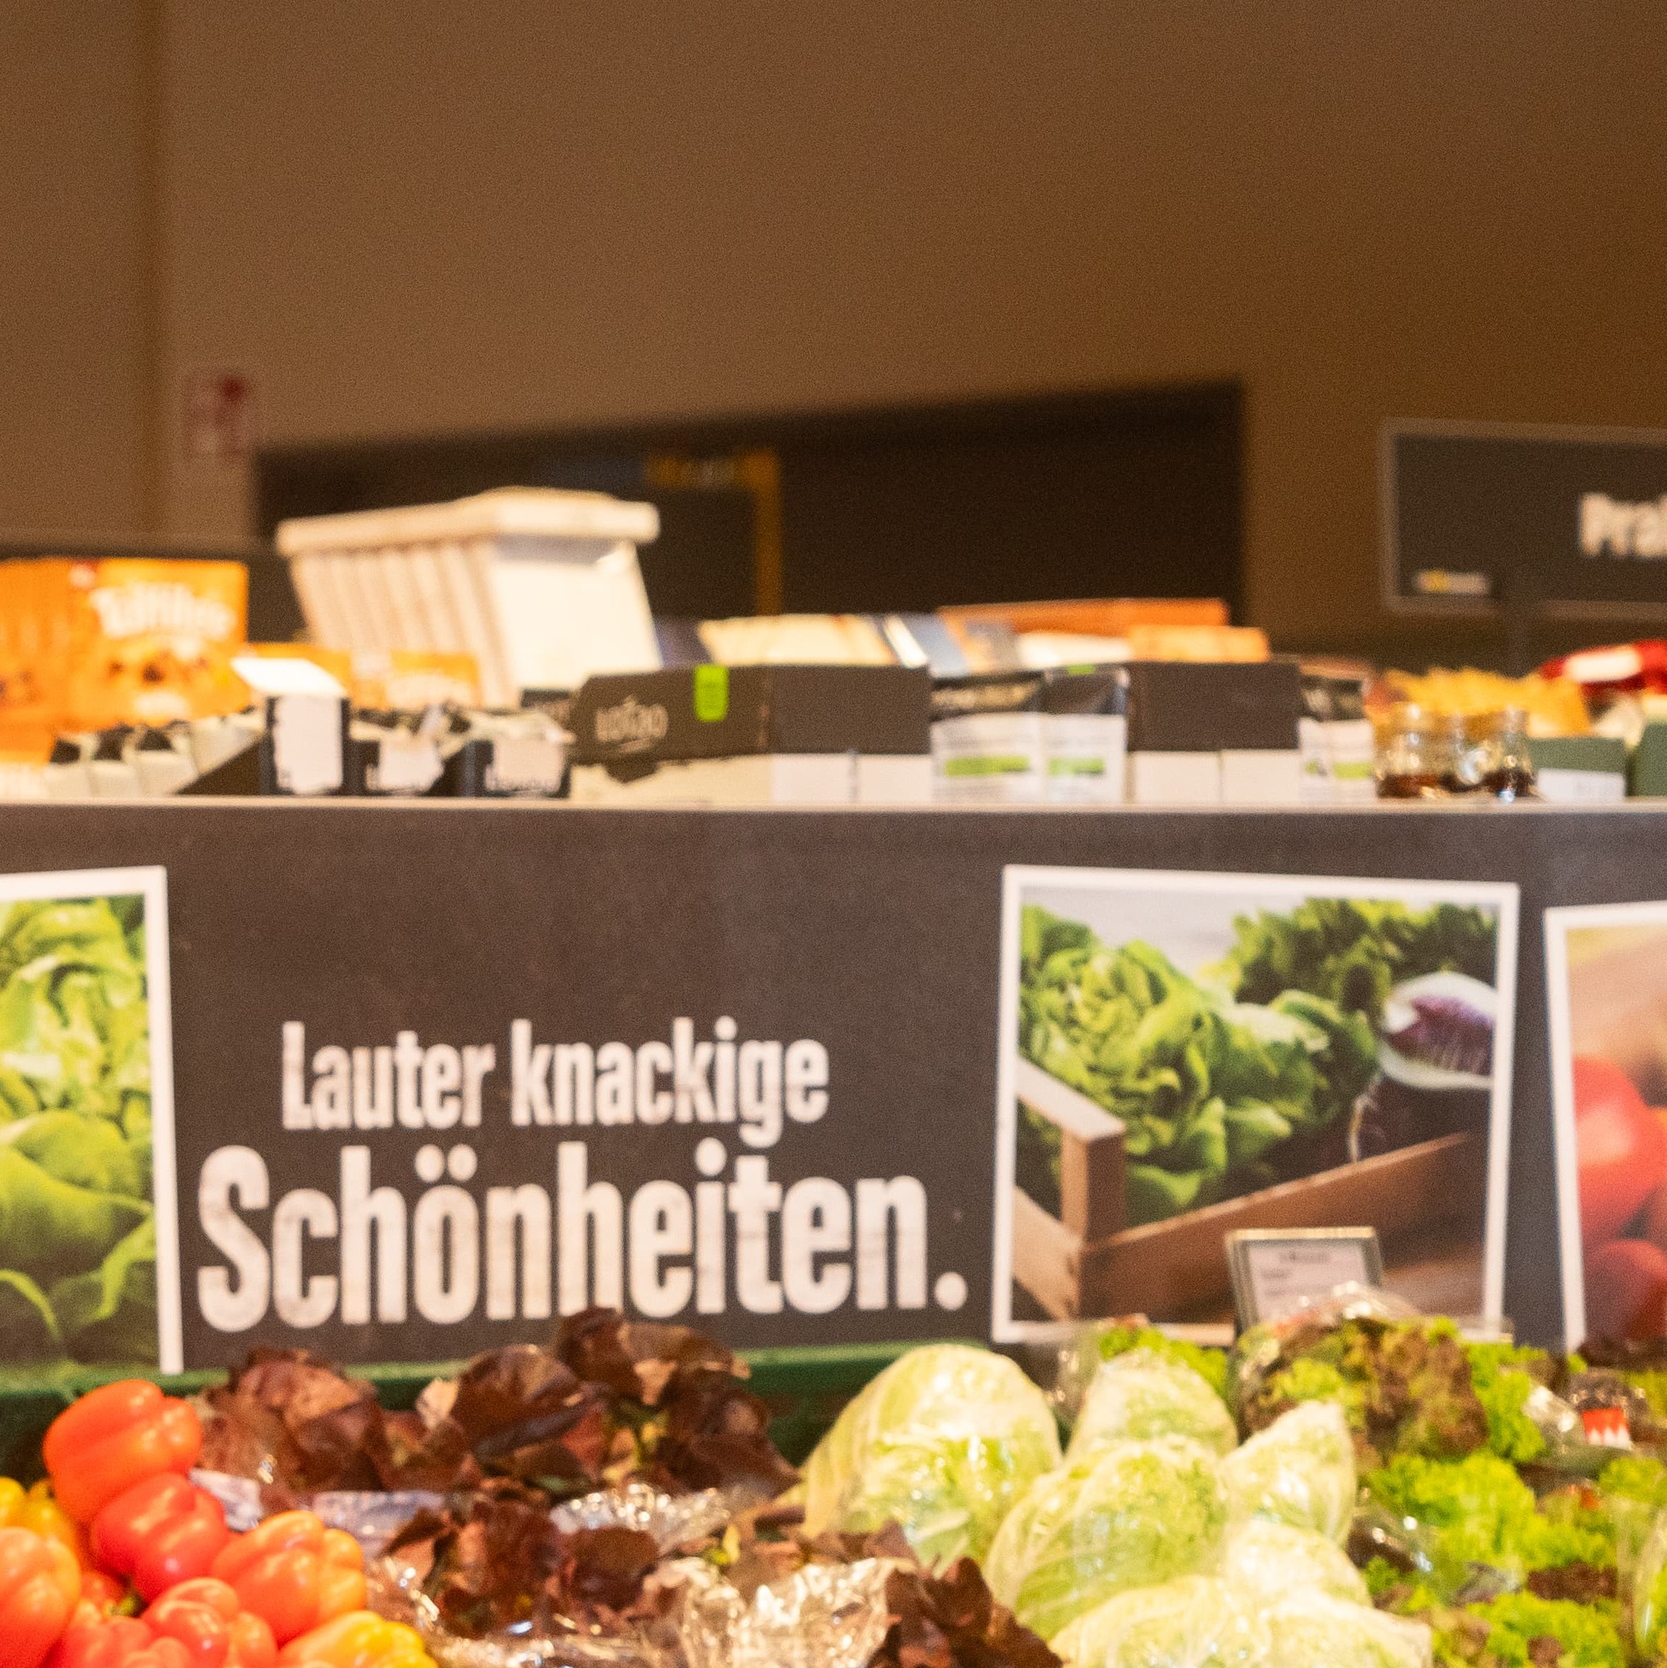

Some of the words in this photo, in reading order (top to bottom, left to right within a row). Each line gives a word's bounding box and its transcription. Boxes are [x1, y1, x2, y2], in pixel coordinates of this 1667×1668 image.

[281, 1020, 496, 1132] Lauter
[510, 1016, 830, 1149] knackige
[195, 1137, 969, 1333] Schönheiten.
